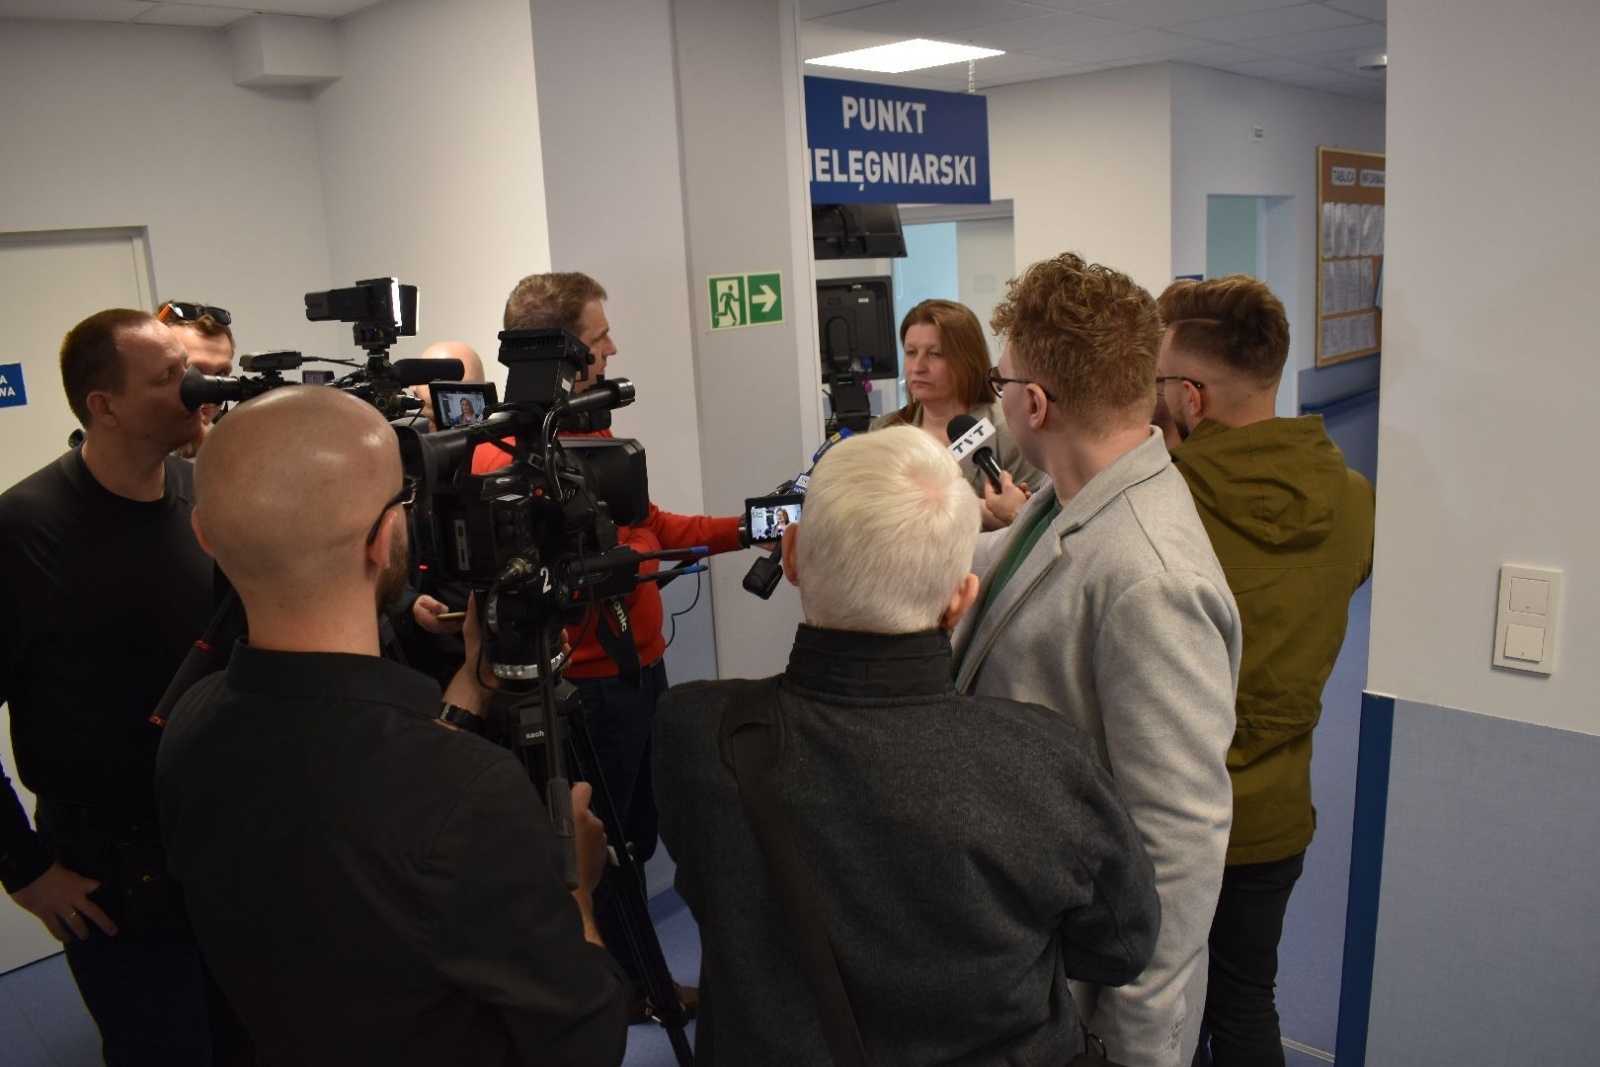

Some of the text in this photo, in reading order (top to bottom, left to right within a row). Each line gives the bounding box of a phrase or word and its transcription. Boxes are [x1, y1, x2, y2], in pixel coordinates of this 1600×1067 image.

[842, 95, 926, 134] PUNKT
[808, 147, 977, 191] IELĘGNIARSKI
[0, 375, 8, 384] A
[953, 425, 986, 454] TVT
[540, 566, 552, 594] 2
[612, 600, 628, 633] onic
[525, 730, 545, 739] sach
